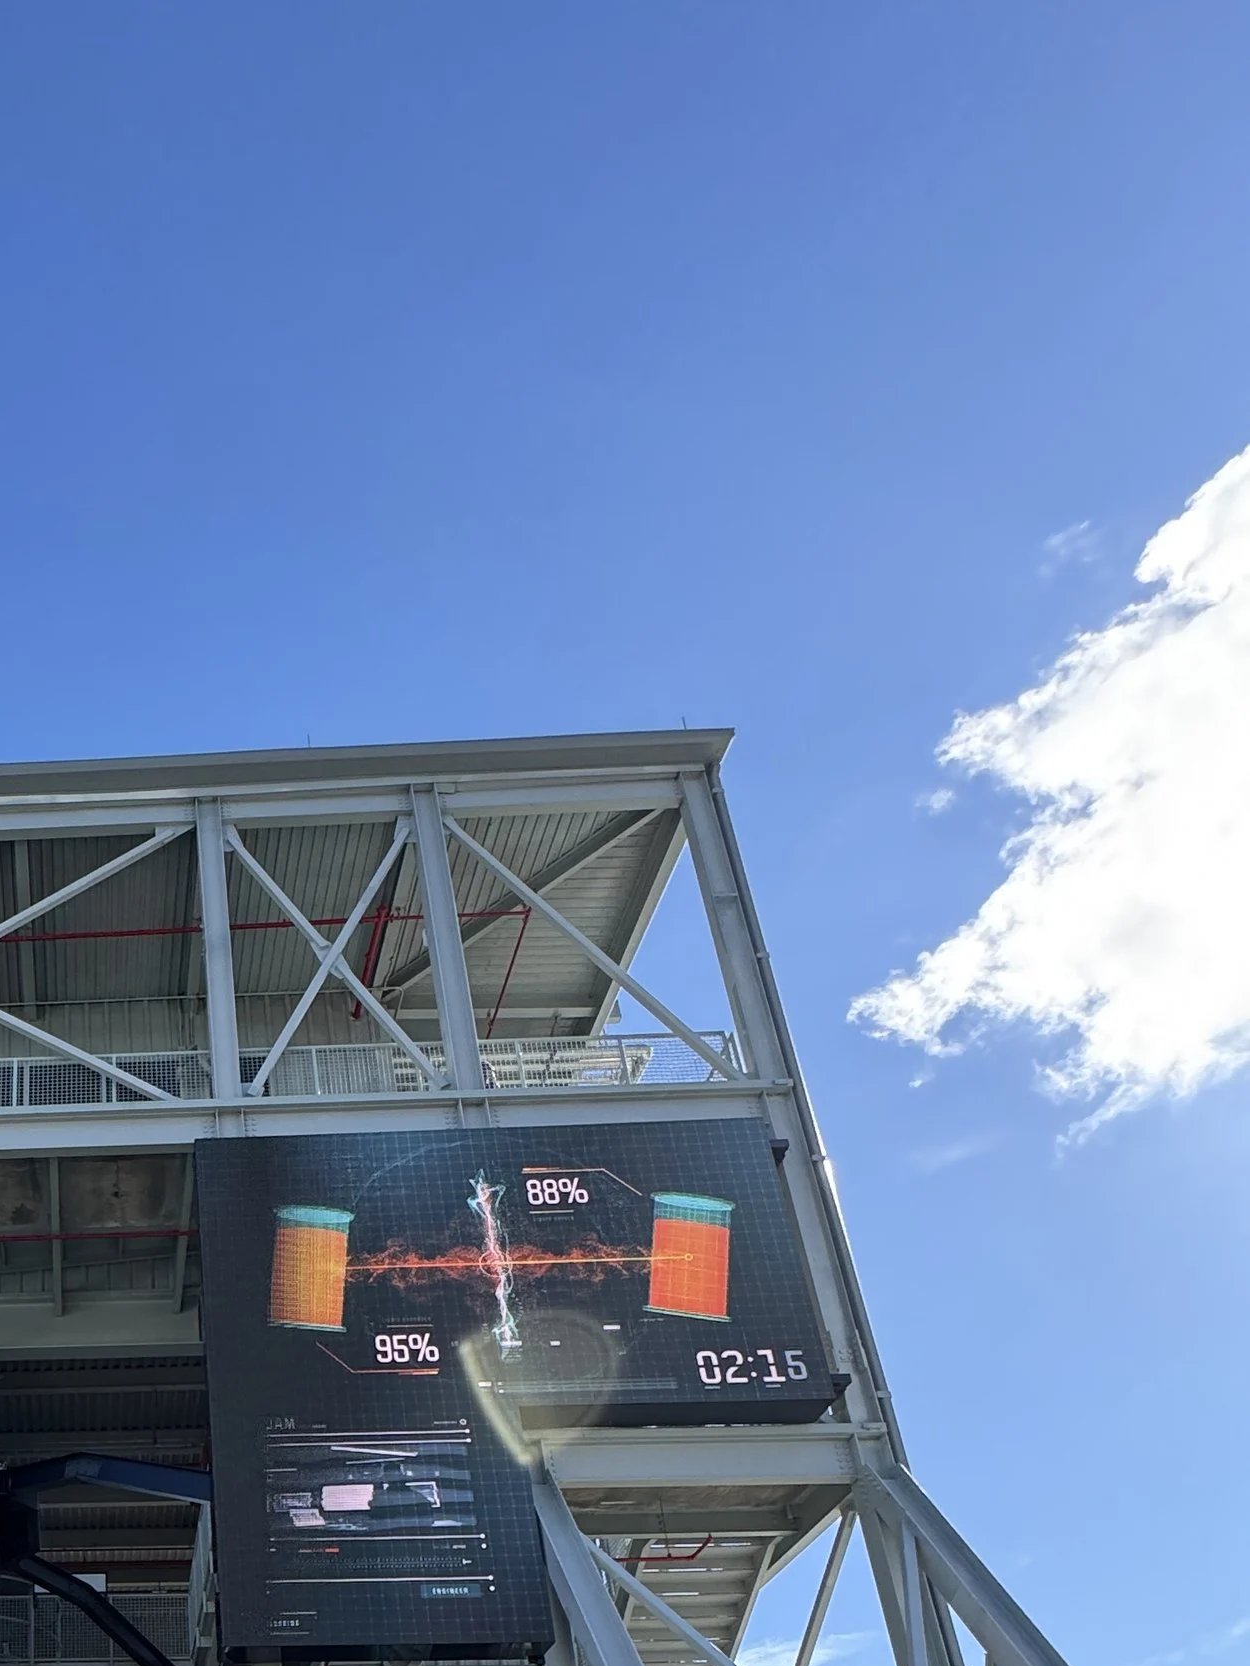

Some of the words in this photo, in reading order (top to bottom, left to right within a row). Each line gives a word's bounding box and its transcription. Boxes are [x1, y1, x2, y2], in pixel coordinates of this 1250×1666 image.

[525, 1177, 589, 1205] 88%
[375, 1333, 440, 1363] 95%
[696, 1349, 808, 1384] 02:15
